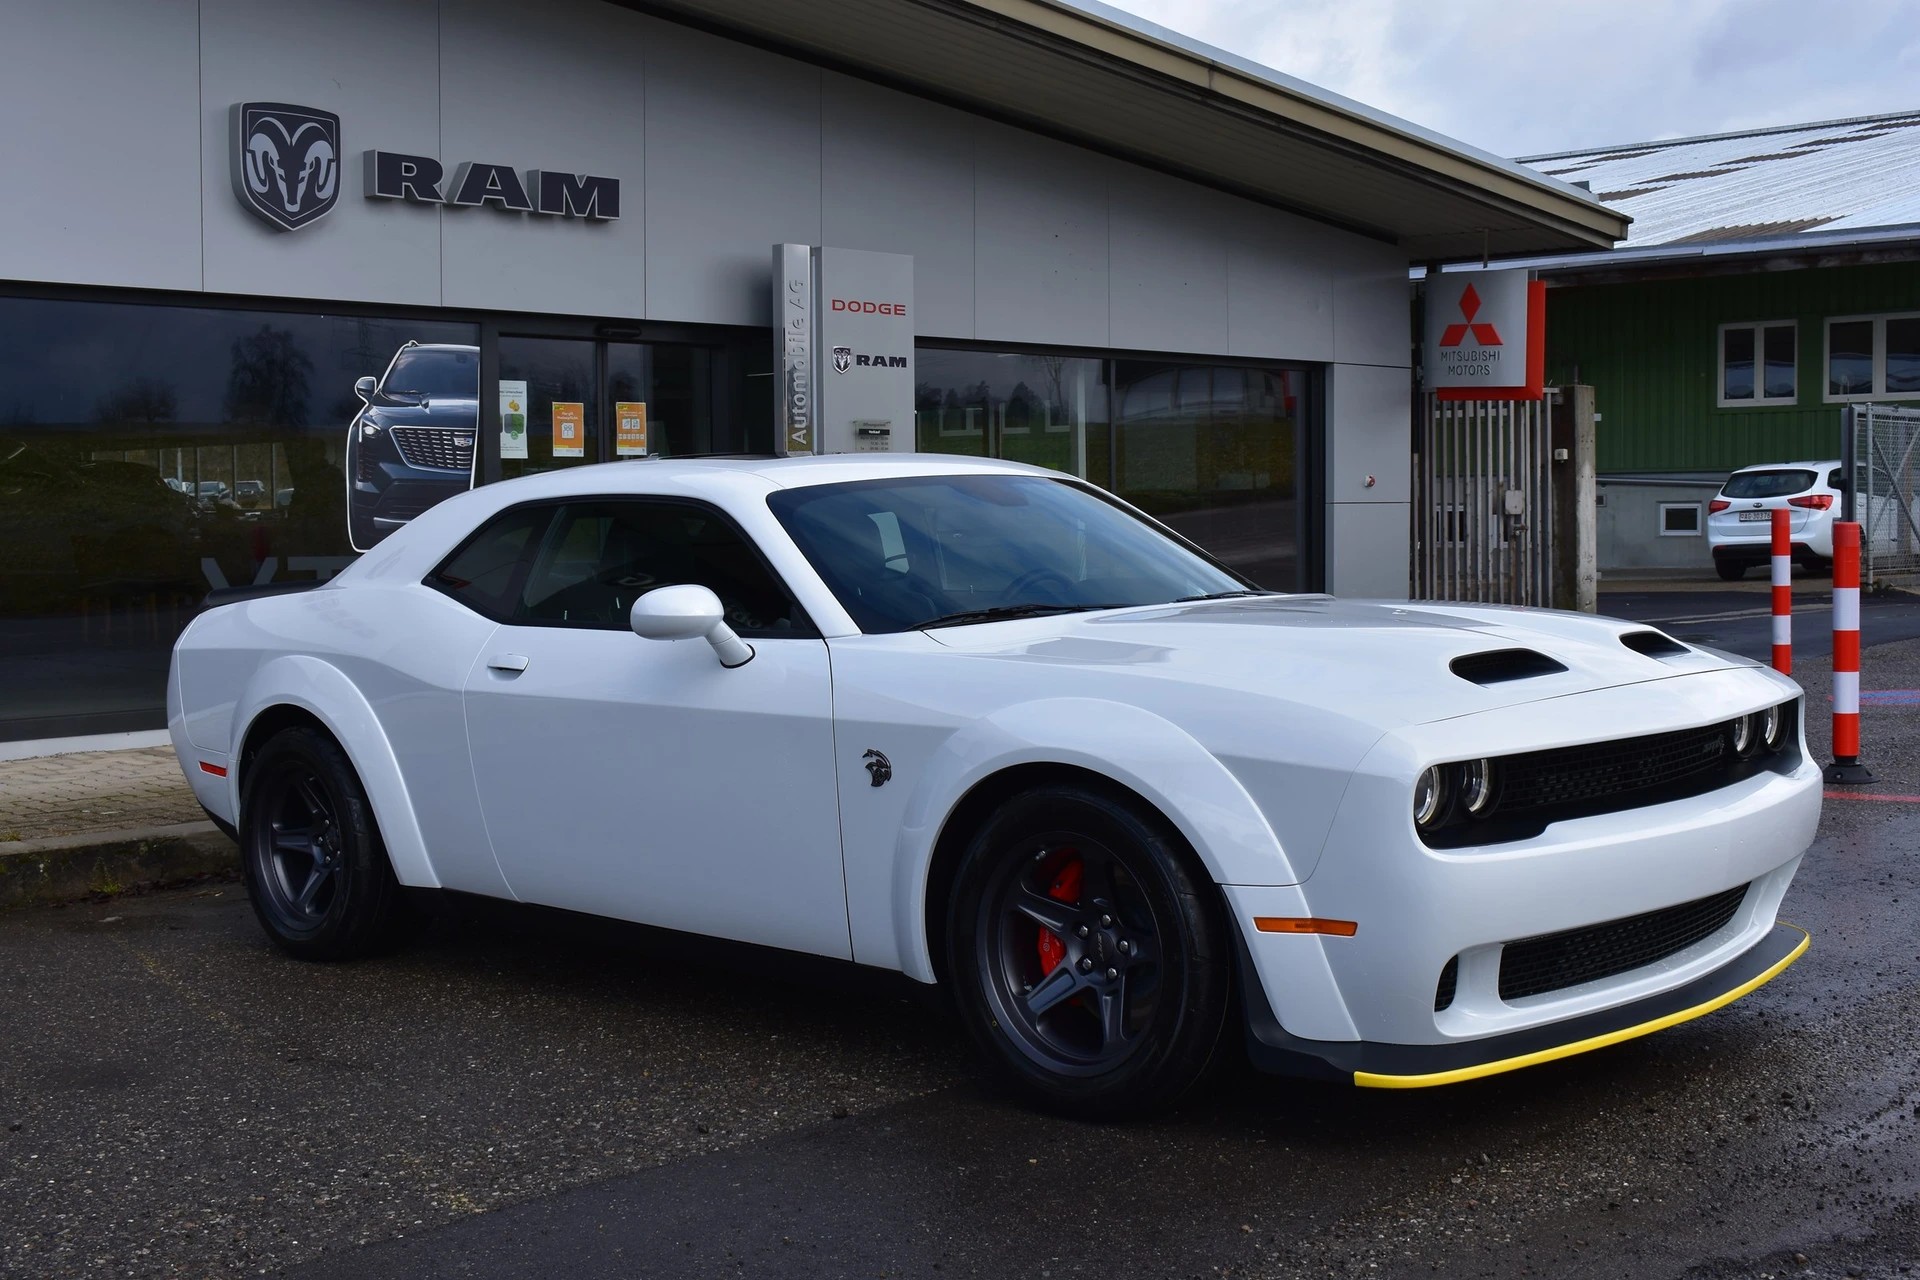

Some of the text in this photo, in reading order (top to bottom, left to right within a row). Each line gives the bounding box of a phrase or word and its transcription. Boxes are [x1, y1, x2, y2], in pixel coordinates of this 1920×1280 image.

[364, 149, 621, 220] RAM
[832, 299, 906, 315] DODGE
[856, 354, 907, 368] RAM
[1441, 350, 1500, 362] MITSUBISHI
[1448, 365, 1491, 376] MOTORS
[788, 317, 807, 445] Automobile
